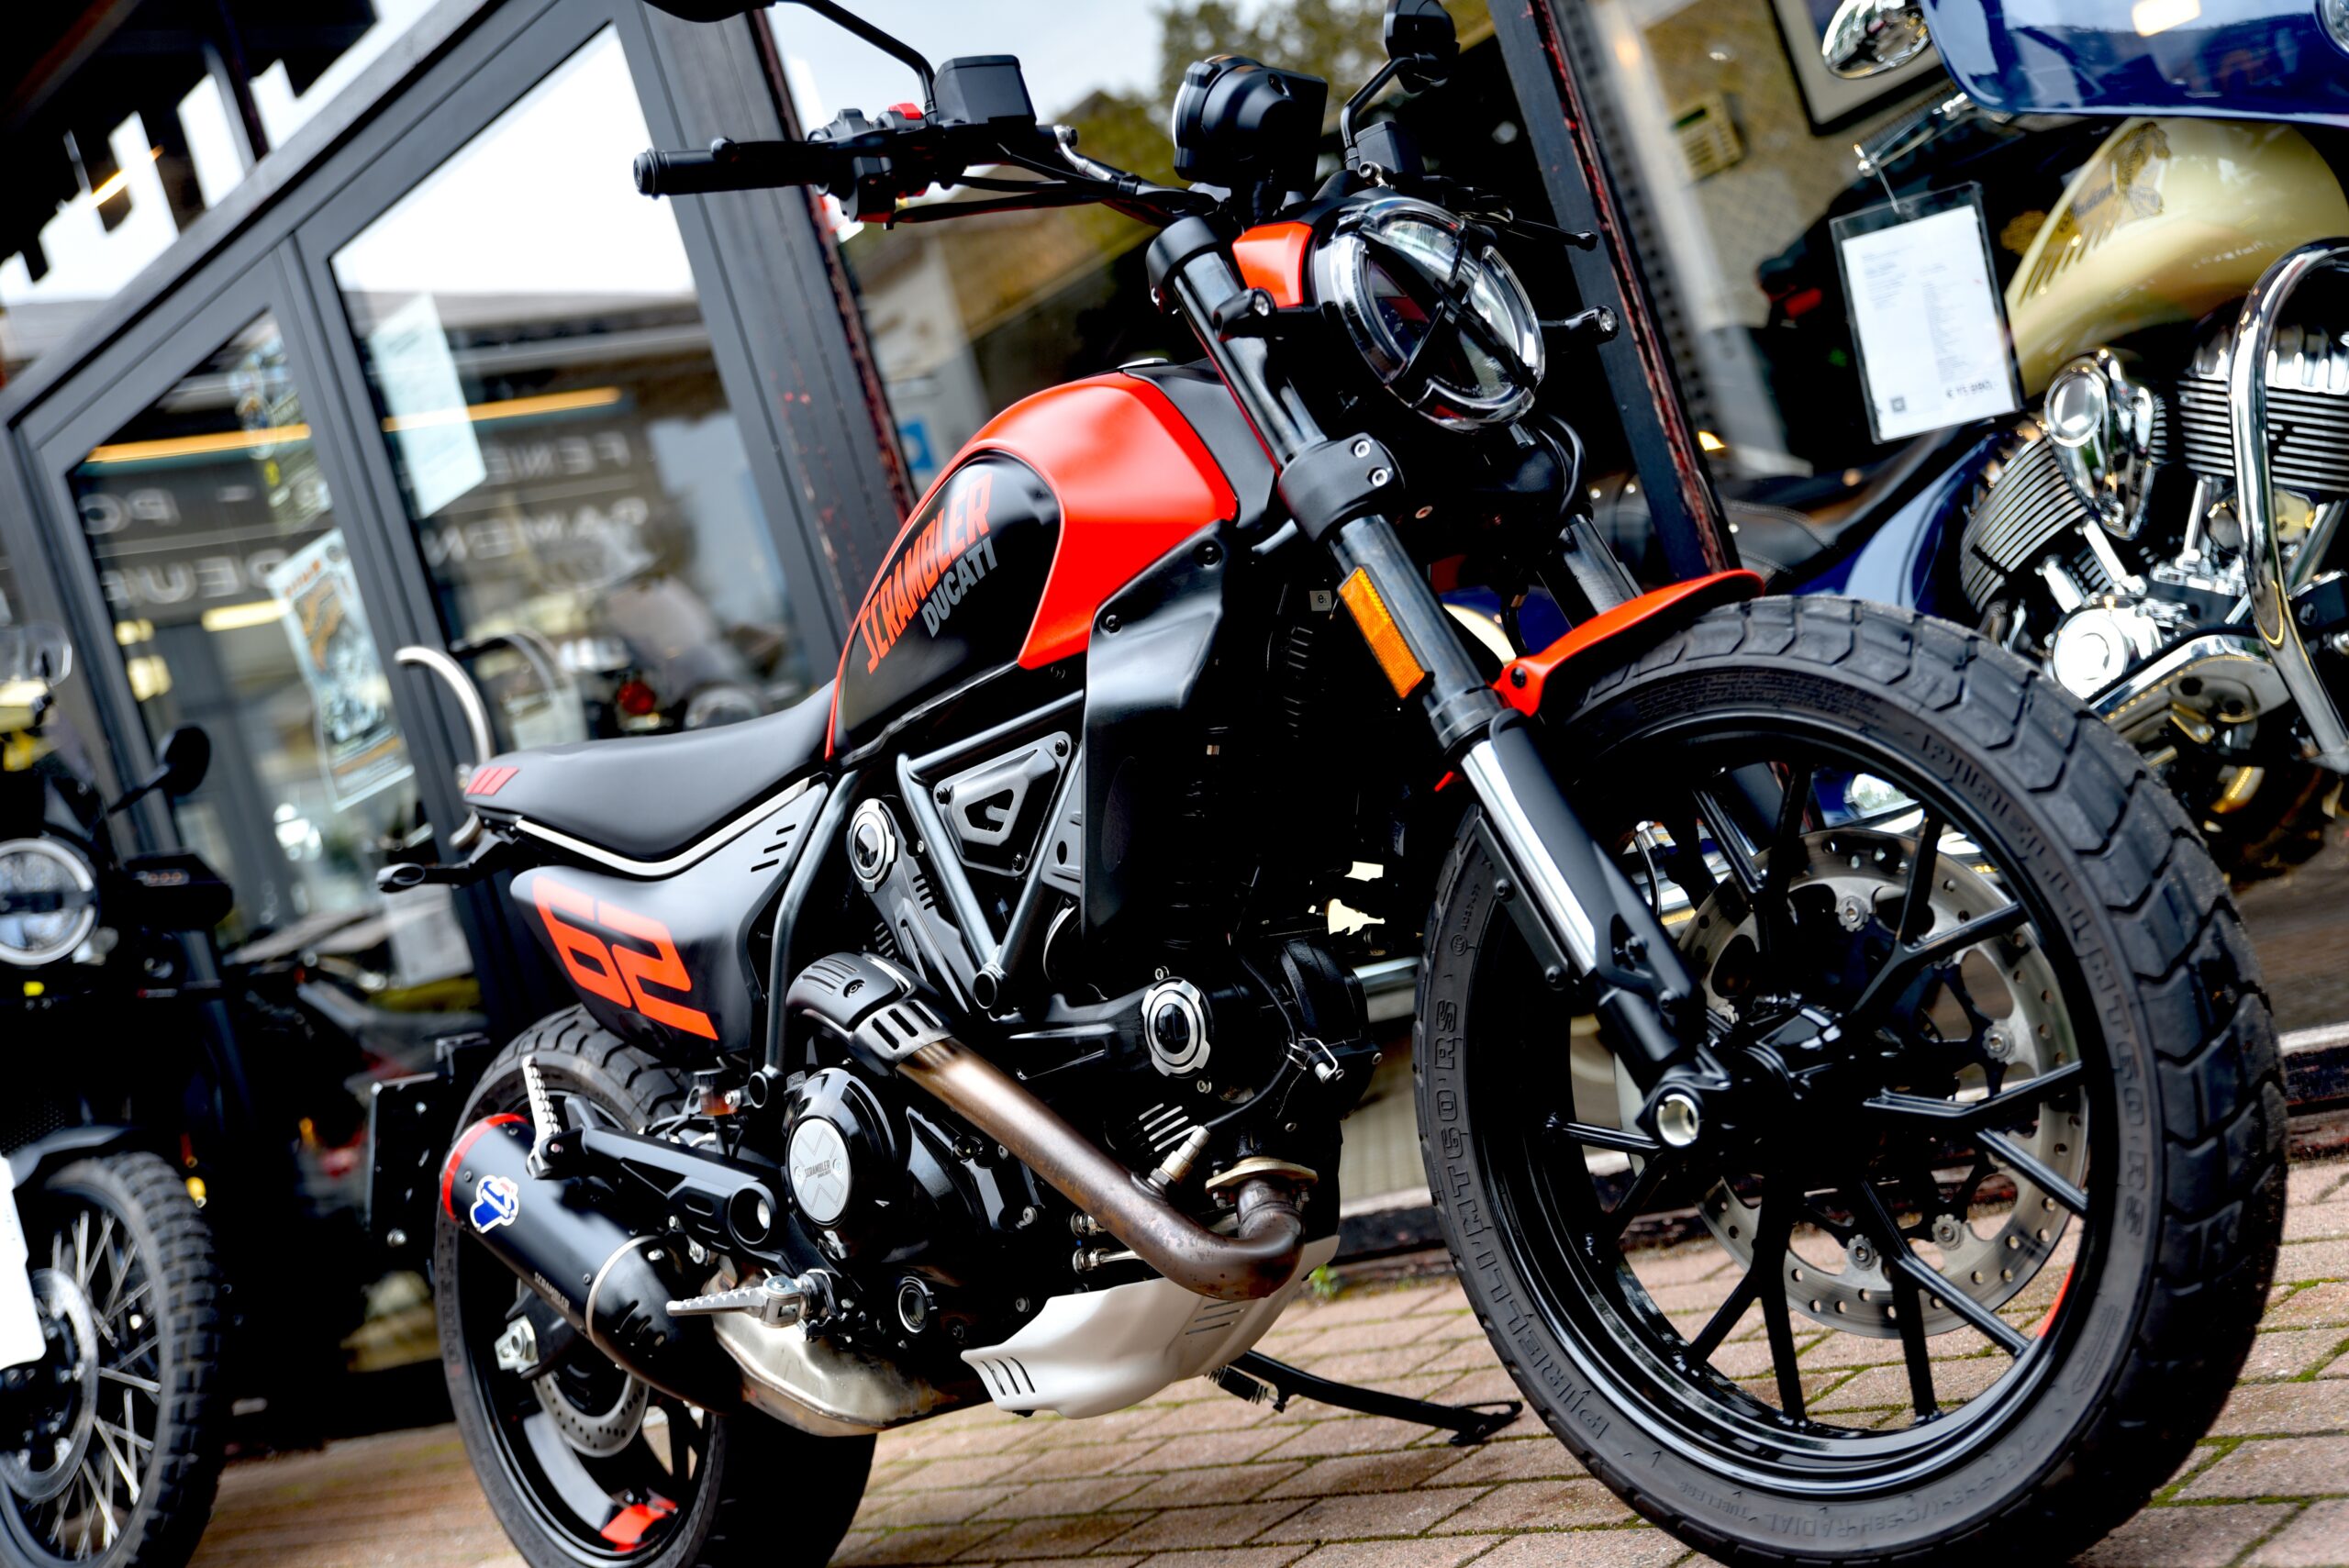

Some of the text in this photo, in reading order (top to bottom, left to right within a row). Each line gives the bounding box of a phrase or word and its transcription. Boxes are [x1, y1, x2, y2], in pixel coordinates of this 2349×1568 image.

[860, 473, 993, 674] SCRAMBLER
[921, 536, 997, 639] DUCATI
[531, 874, 718, 1041] 62
[1434, 997, 1460, 1071] RS
[805, 1160, 829, 1178] SCRAMBLER
[1470, 1246, 1611, 1442] PIRELLI
